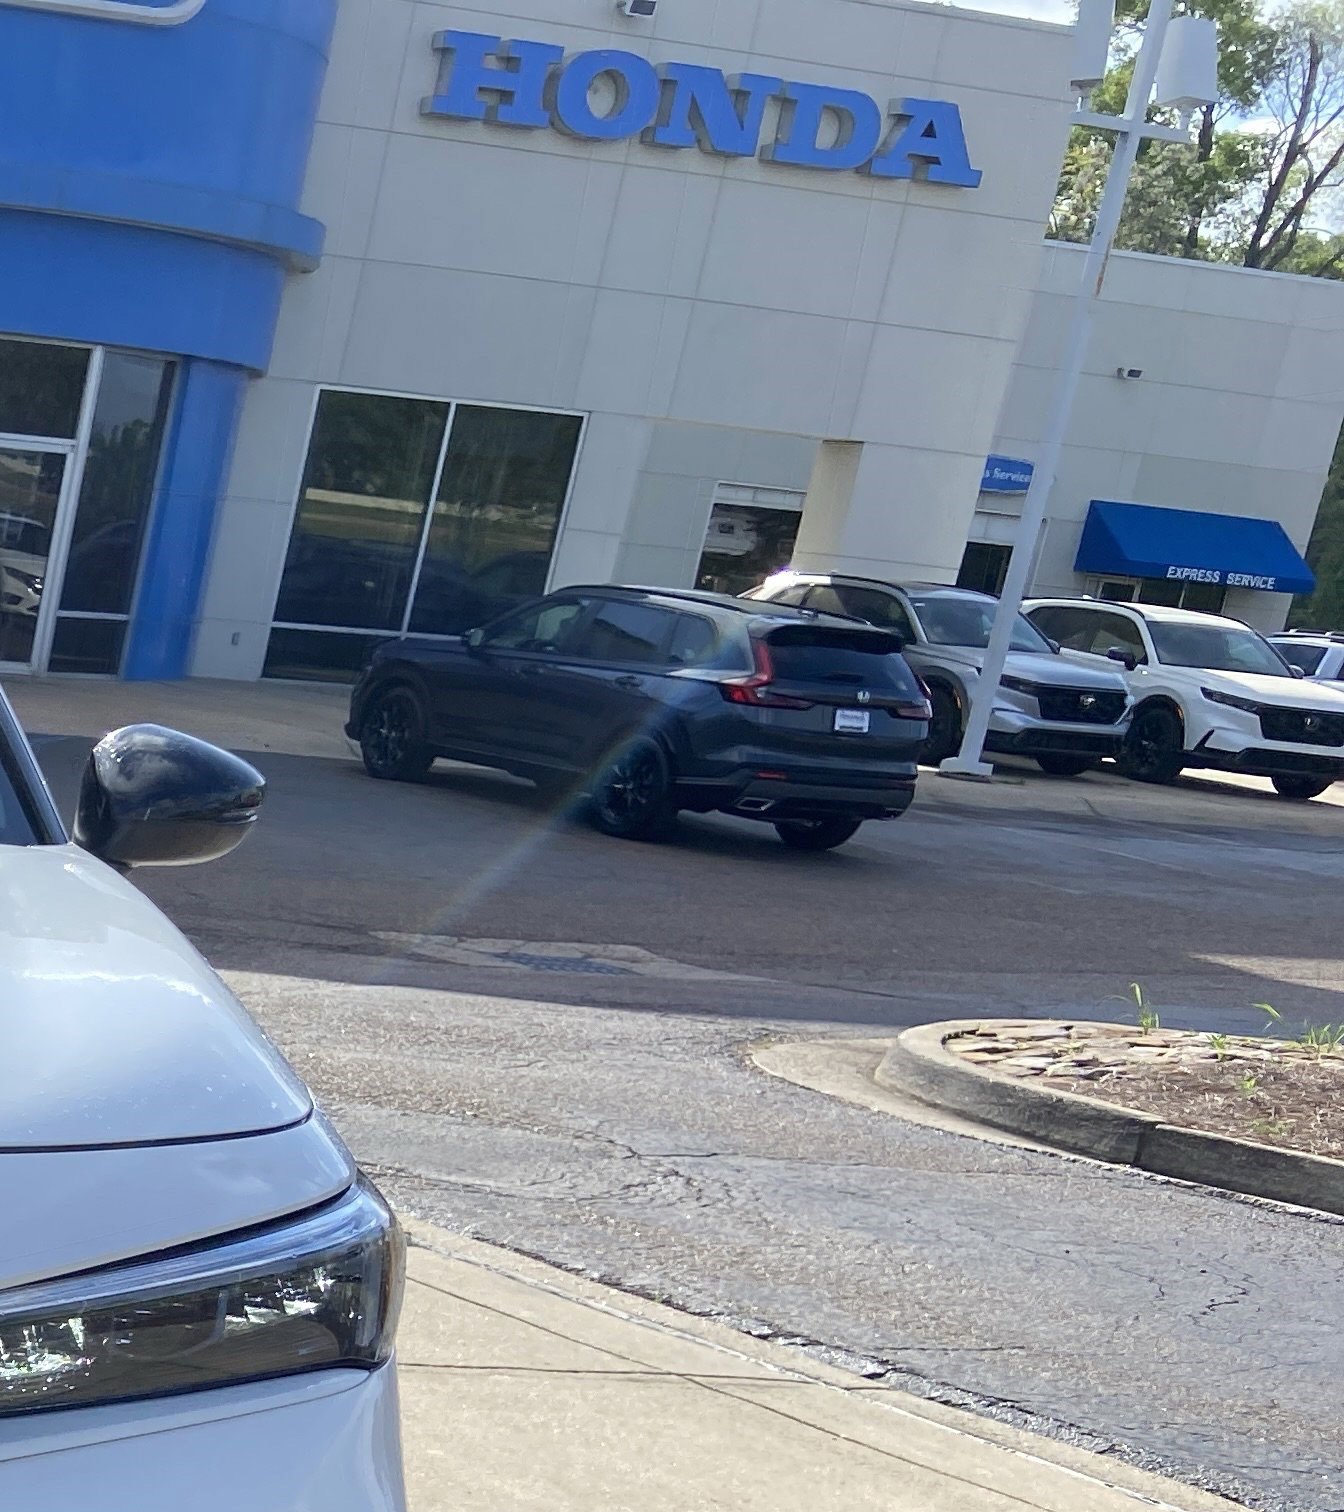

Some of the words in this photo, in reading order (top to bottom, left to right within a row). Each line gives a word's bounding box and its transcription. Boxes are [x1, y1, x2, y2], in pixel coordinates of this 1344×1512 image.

[422, 29, 983, 188] HONDA
[993, 467, 1032, 482] Service
[1167, 566, 1221, 583] EXPRESS
[1226, 572, 1276, 589] SERVICE
